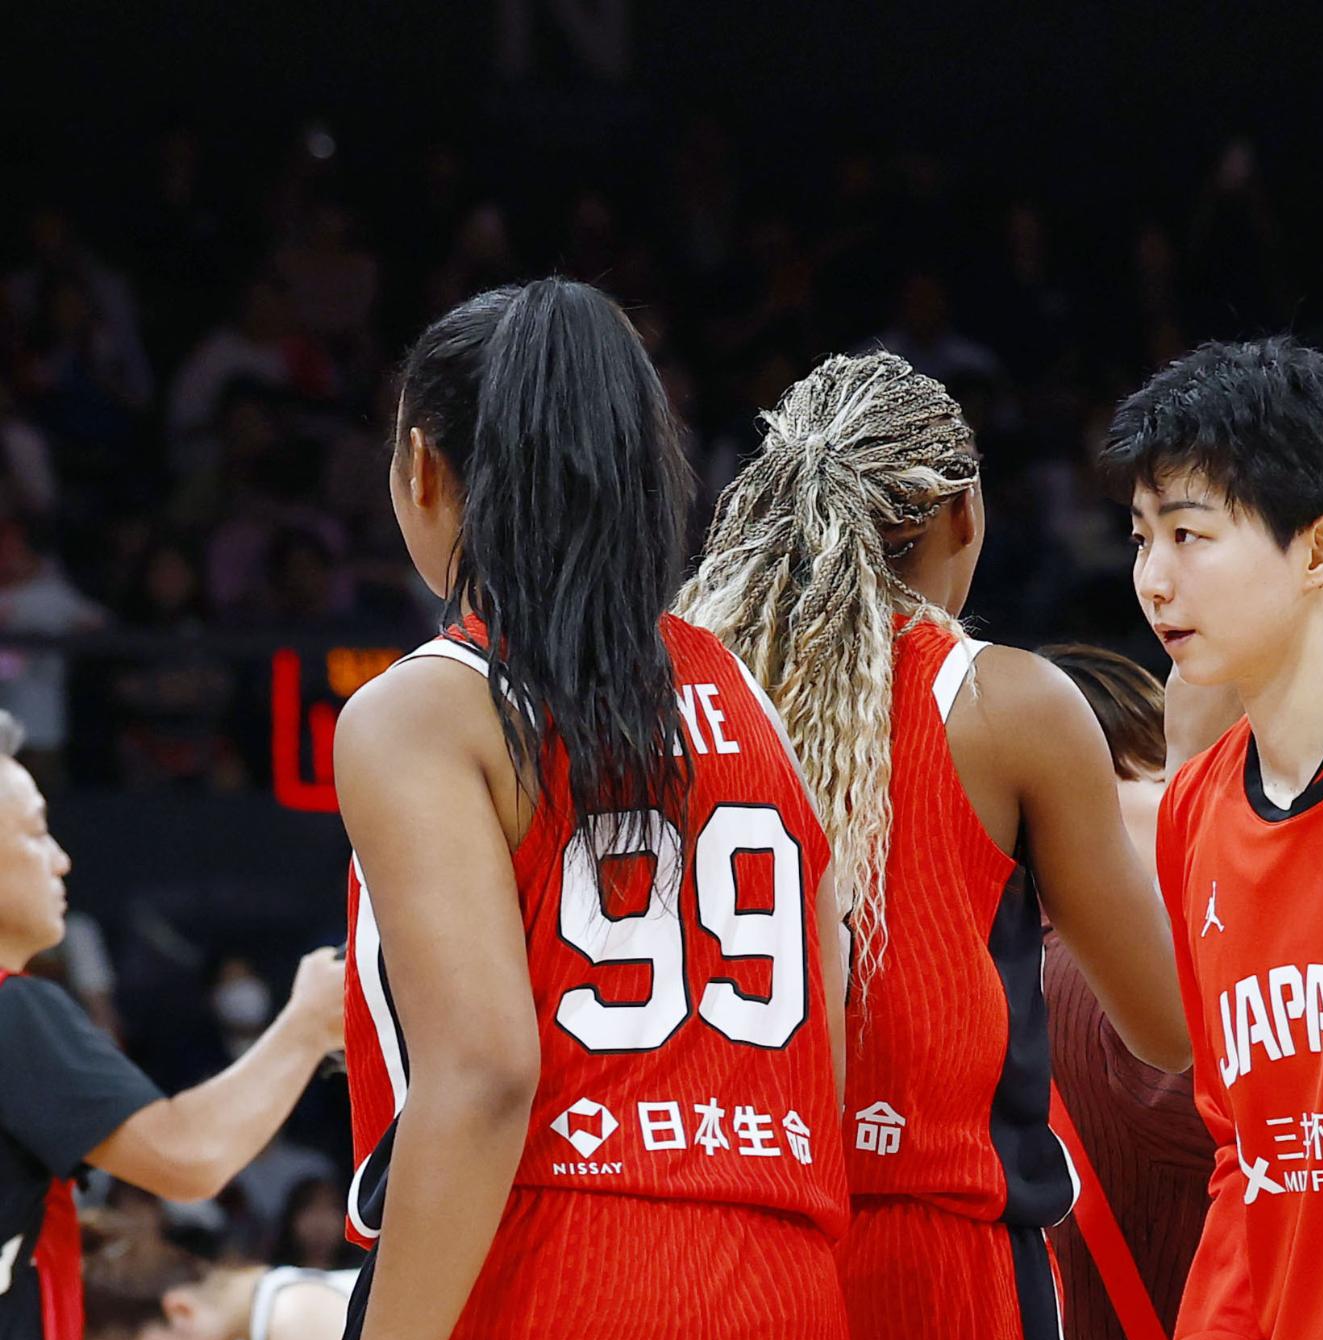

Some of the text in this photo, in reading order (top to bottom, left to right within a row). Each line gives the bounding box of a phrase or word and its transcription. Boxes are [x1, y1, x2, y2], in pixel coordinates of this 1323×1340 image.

[556, 803, 808, 1054] 99
[637, 1097, 813, 1165] 日本生命
[843, 1101, 906, 1156] 命
[553, 1162, 622, 1175] NISSAY
